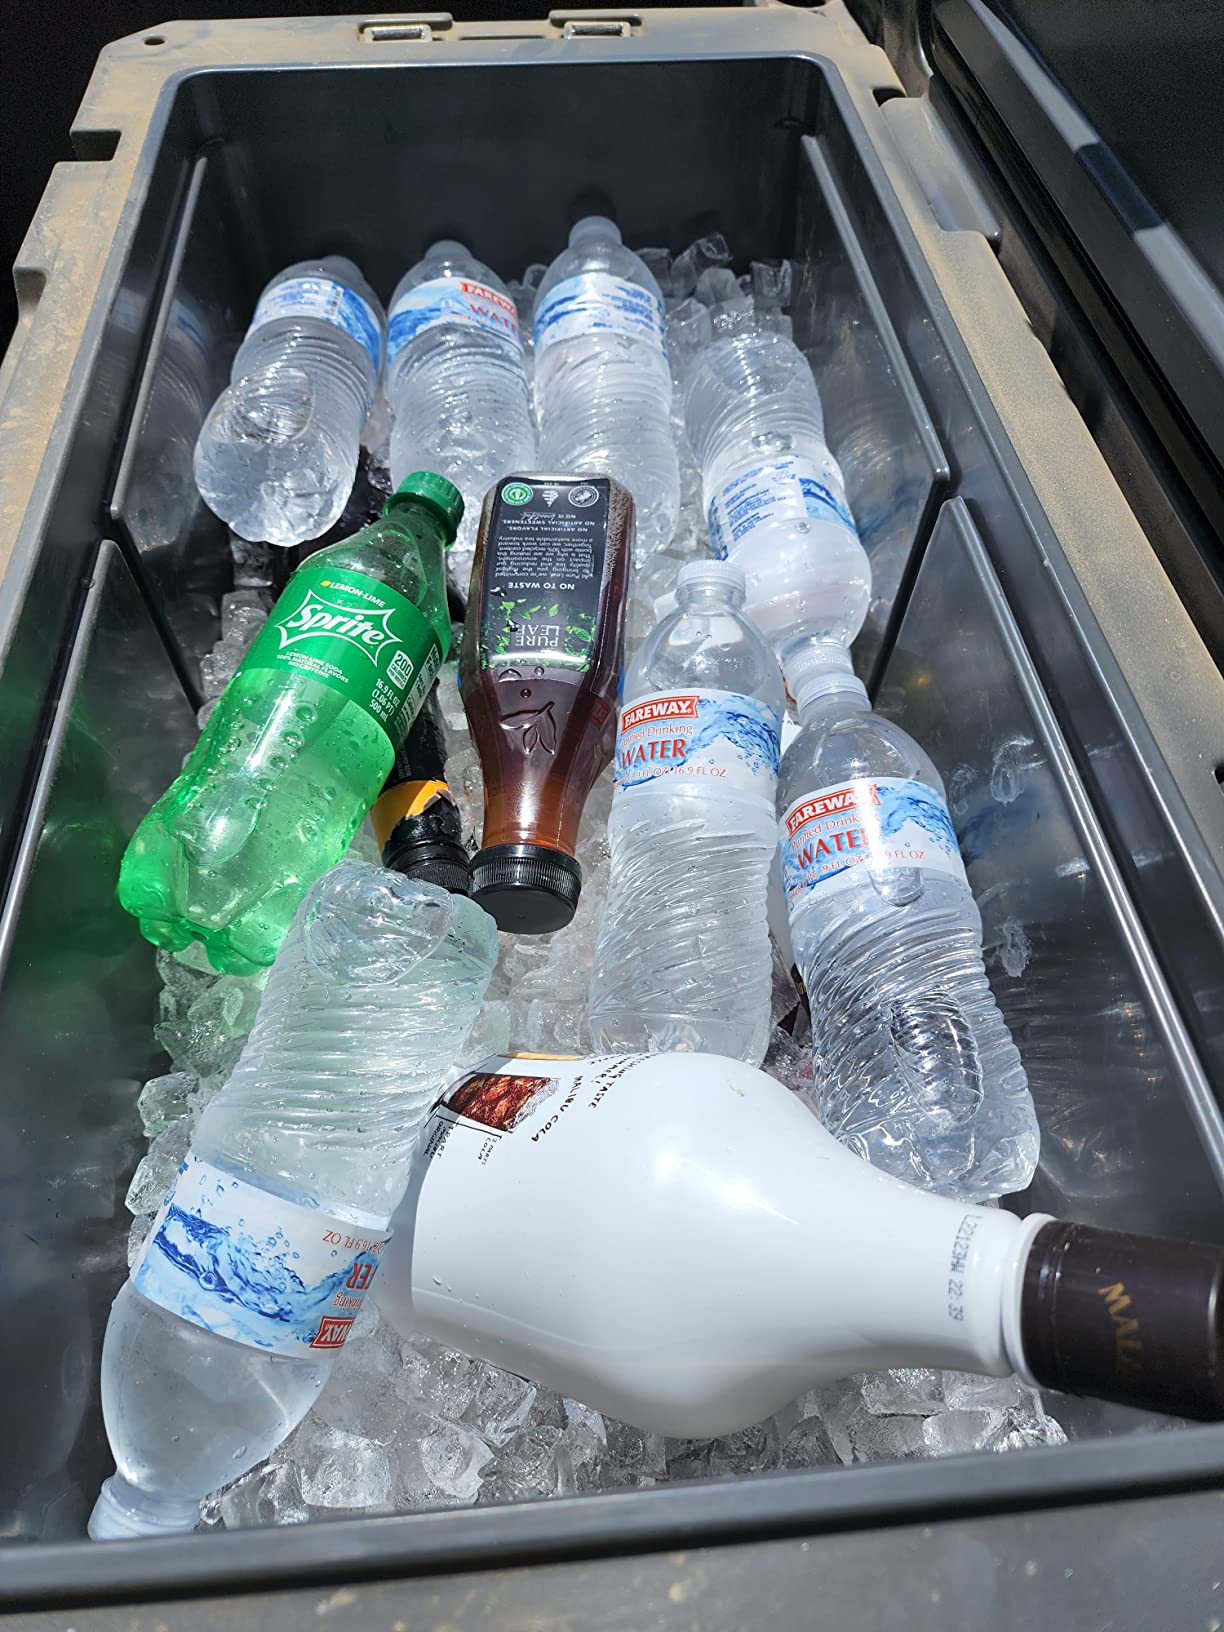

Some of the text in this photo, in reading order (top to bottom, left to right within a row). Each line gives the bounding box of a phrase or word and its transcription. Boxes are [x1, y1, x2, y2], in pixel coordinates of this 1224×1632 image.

[329, 582, 386, 608] LEMON-LIME
[286, 604, 384, 644] Sprite
[516, 624, 560, 636] LEAF
[514, 635, 560, 648] PURE
[292, 657, 320, 669] NATURAL
[321, 667, 349, 683] FLAVORS
[394, 654, 411, 676] 200
[369, 699, 381, 713] 500
[372, 689, 395, 716] (1.06 PT)
[376, 678, 400, 708] 16.9 FL OZ
[624, 700, 690, 728] FAREWAY
[648, 724, 693, 736] Drinking
[622, 738, 686, 768] WATER
[697, 767, 707, 775] FL
[710, 769, 726, 777] OZ
[790, 792, 863, 832] FAREWA
[792, 811, 868, 852] Purified Drink
[909, 850, 924, 859] OZ
[589, 1081, 615, 1108] TASTE
[531, 1075, 583, 1142] MALIBU COLA
[424, 1121, 444, 1156] ORIGINAL
[478, 1137, 491, 1160] COLA
[322, 1230, 342, 1244] OZ
[344, 1236, 355, 1249] FL
[355, 1239, 370, 1252] 16.9
